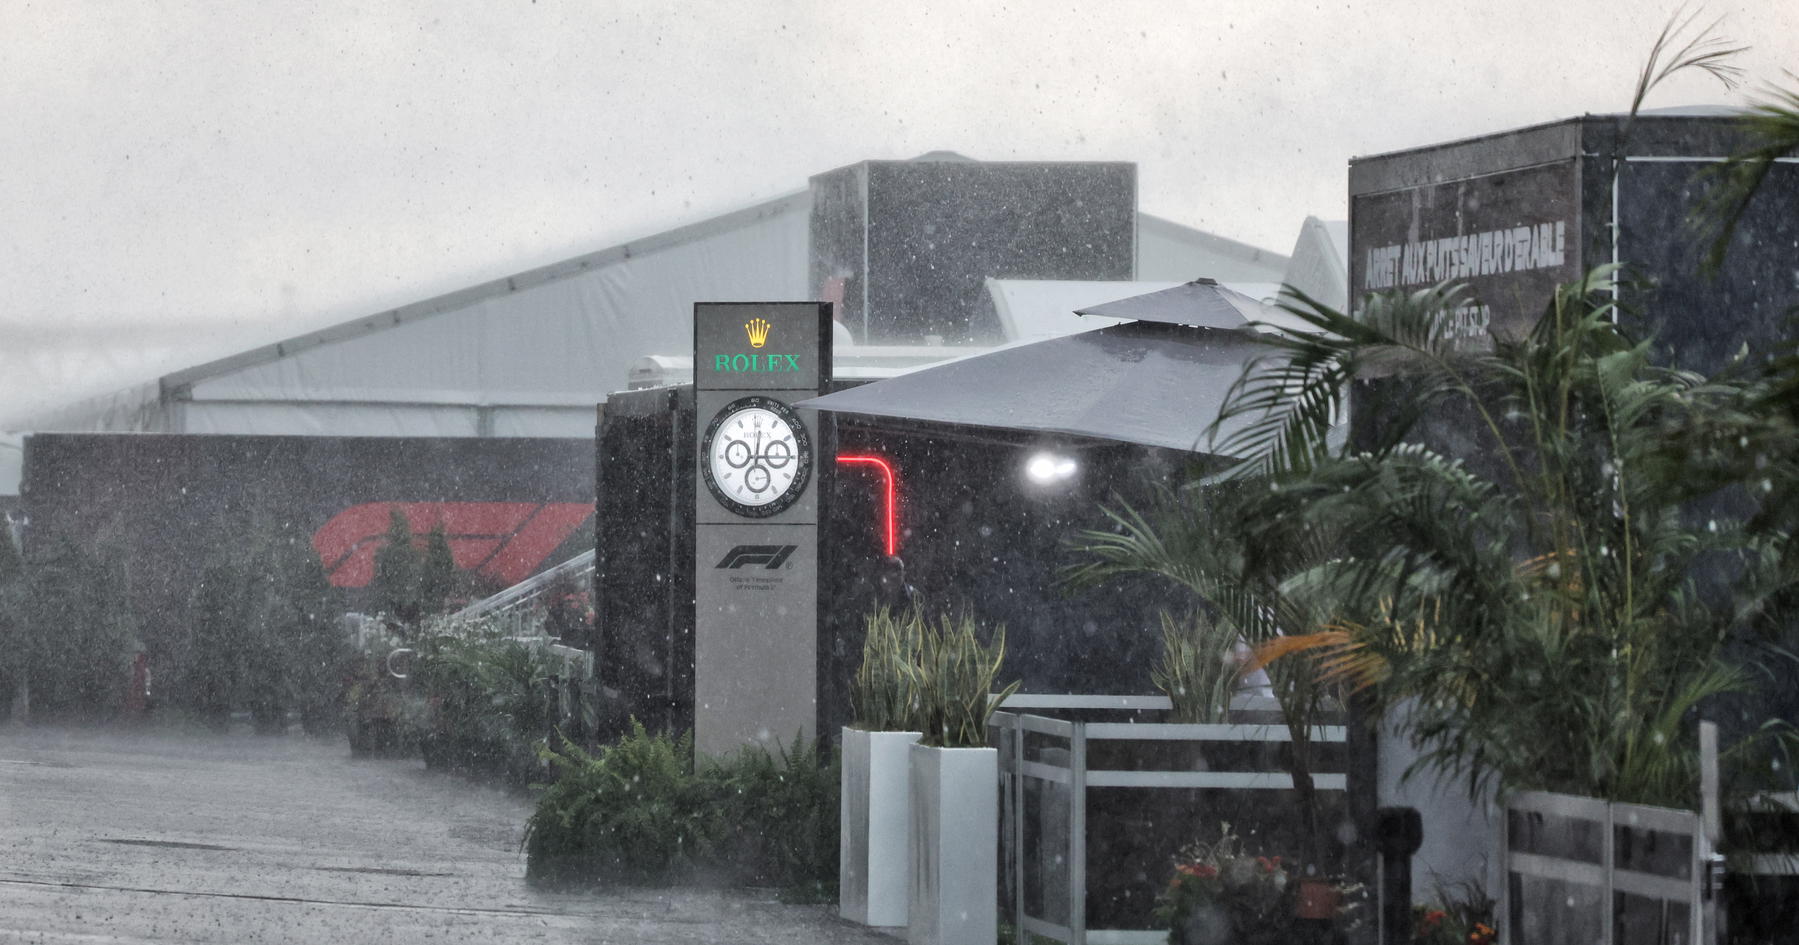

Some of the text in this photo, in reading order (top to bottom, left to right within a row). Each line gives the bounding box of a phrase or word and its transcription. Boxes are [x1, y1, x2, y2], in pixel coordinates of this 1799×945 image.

[1401, 241, 1425, 285] AUX
[1459, 230, 1503, 278] SAVEUR
[714, 353, 800, 373] ROLEX
